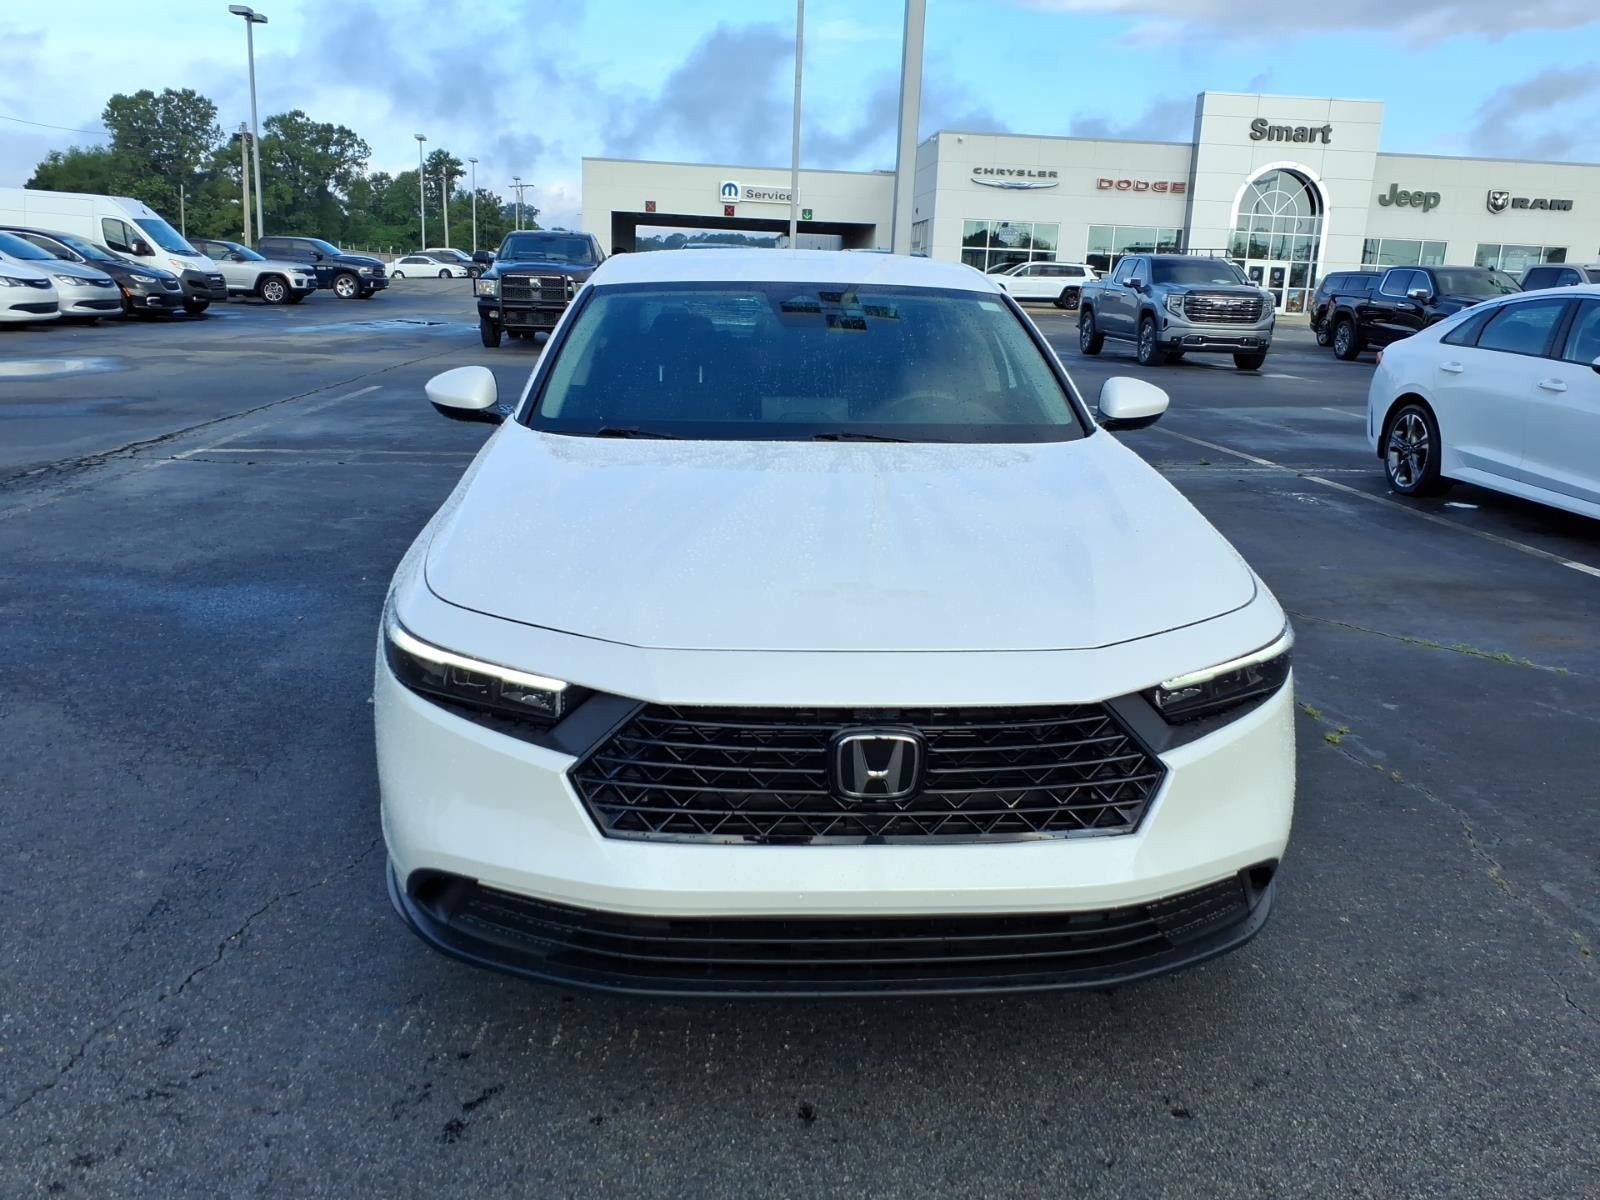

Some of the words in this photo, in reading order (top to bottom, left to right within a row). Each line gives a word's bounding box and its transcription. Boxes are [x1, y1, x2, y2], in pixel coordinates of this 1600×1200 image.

[1249, 118, 1333, 144] Smart
[973, 167, 1058, 178] CHRYSLER
[1097, 178, 1186, 193] DODGE
[746, 189, 792, 201] Service
[1378, 183, 1441, 213] Jeep
[1511, 197, 1574, 211] RAM
